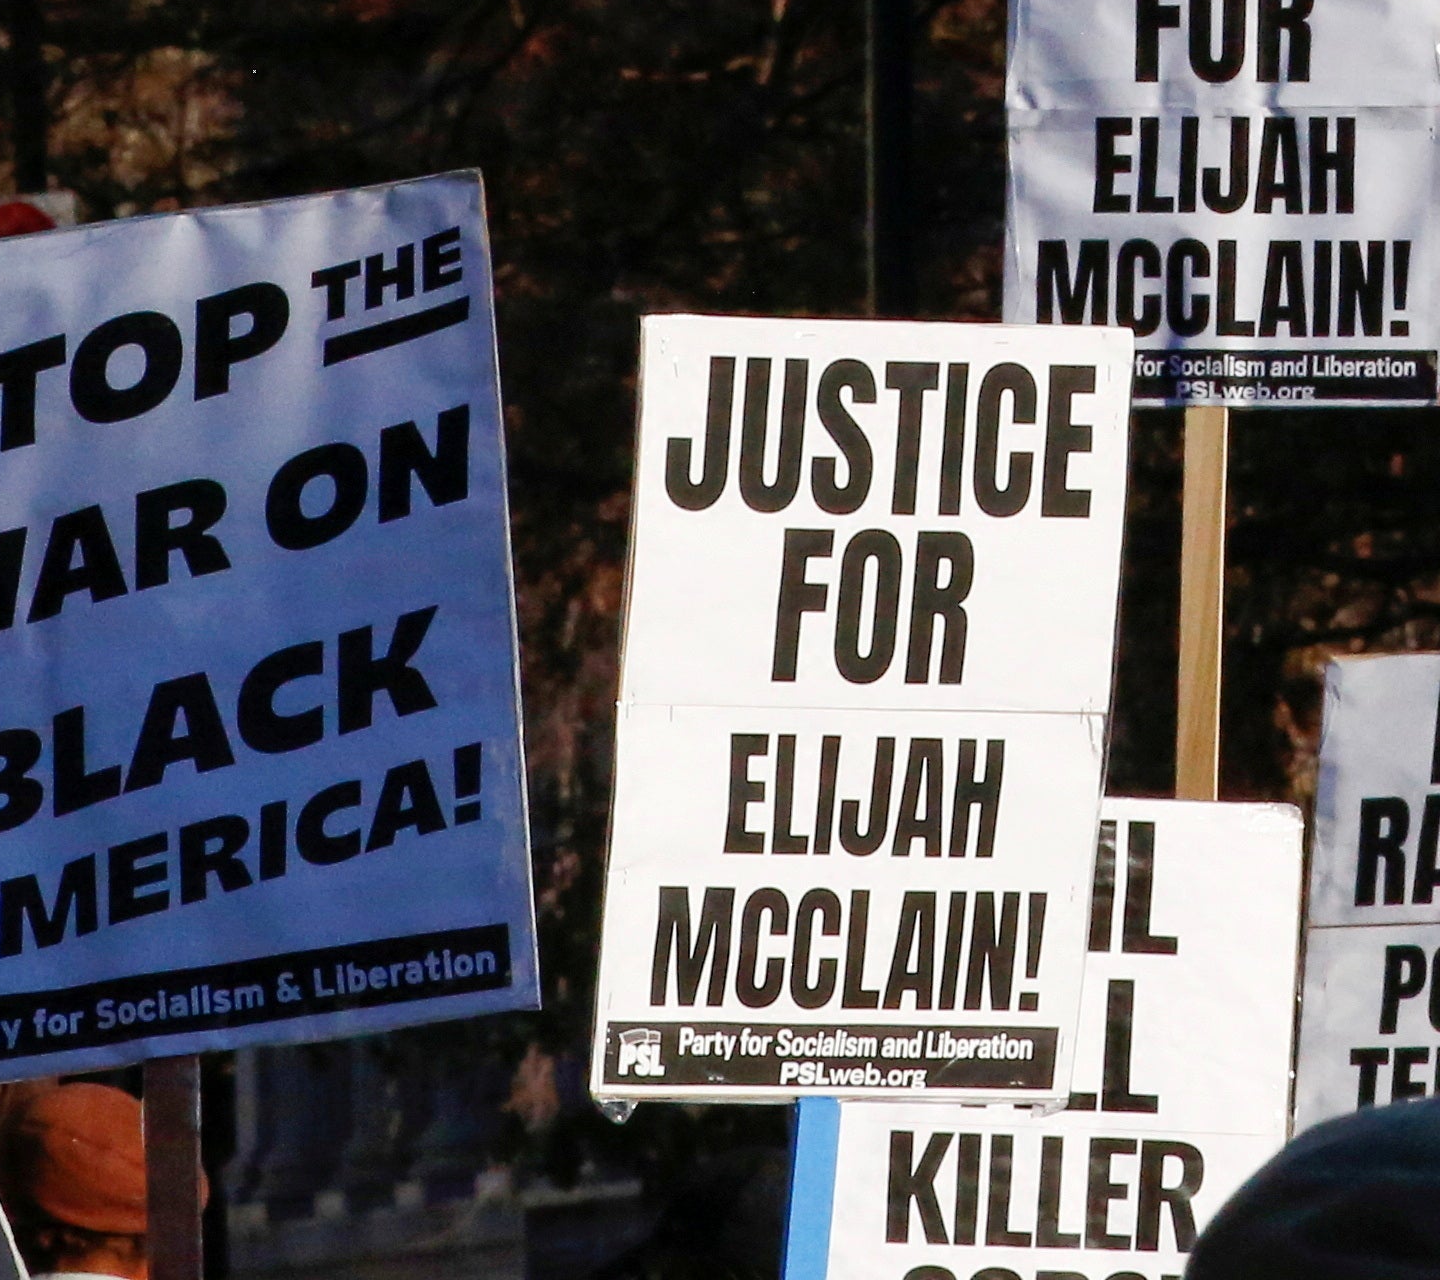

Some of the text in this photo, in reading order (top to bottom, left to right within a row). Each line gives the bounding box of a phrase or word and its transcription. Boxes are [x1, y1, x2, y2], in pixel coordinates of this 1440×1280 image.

[1092, 116, 1357, 215] ELIJAH
[312, 226, 464, 321] THE
[1035, 238, 1412, 339] MCCLAIN!
[1135, 353, 1417, 378] for Socialism and Liberation
[266, 404, 470, 550] ON
[665, 356, 1096, 518] JUSTICE
[771, 528, 974, 684] FOR
[723, 733, 1005, 858] ELIJAH
[33, 1007, 84, 1040] for
[96, 980, 264, 1030] Socialism
[276, 971, 302, 1003] &
[313, 946, 496, 998] Liberation
[650, 886, 1047, 1011] MCCLAIN!
[618, 1043, 665, 1077] PSL
[678, 1027, 1034, 1061] Party for Socialism and Liberation
[779, 1061, 927, 1089] PSLweb.org
[885, 1130, 1205, 1253] KILLER
